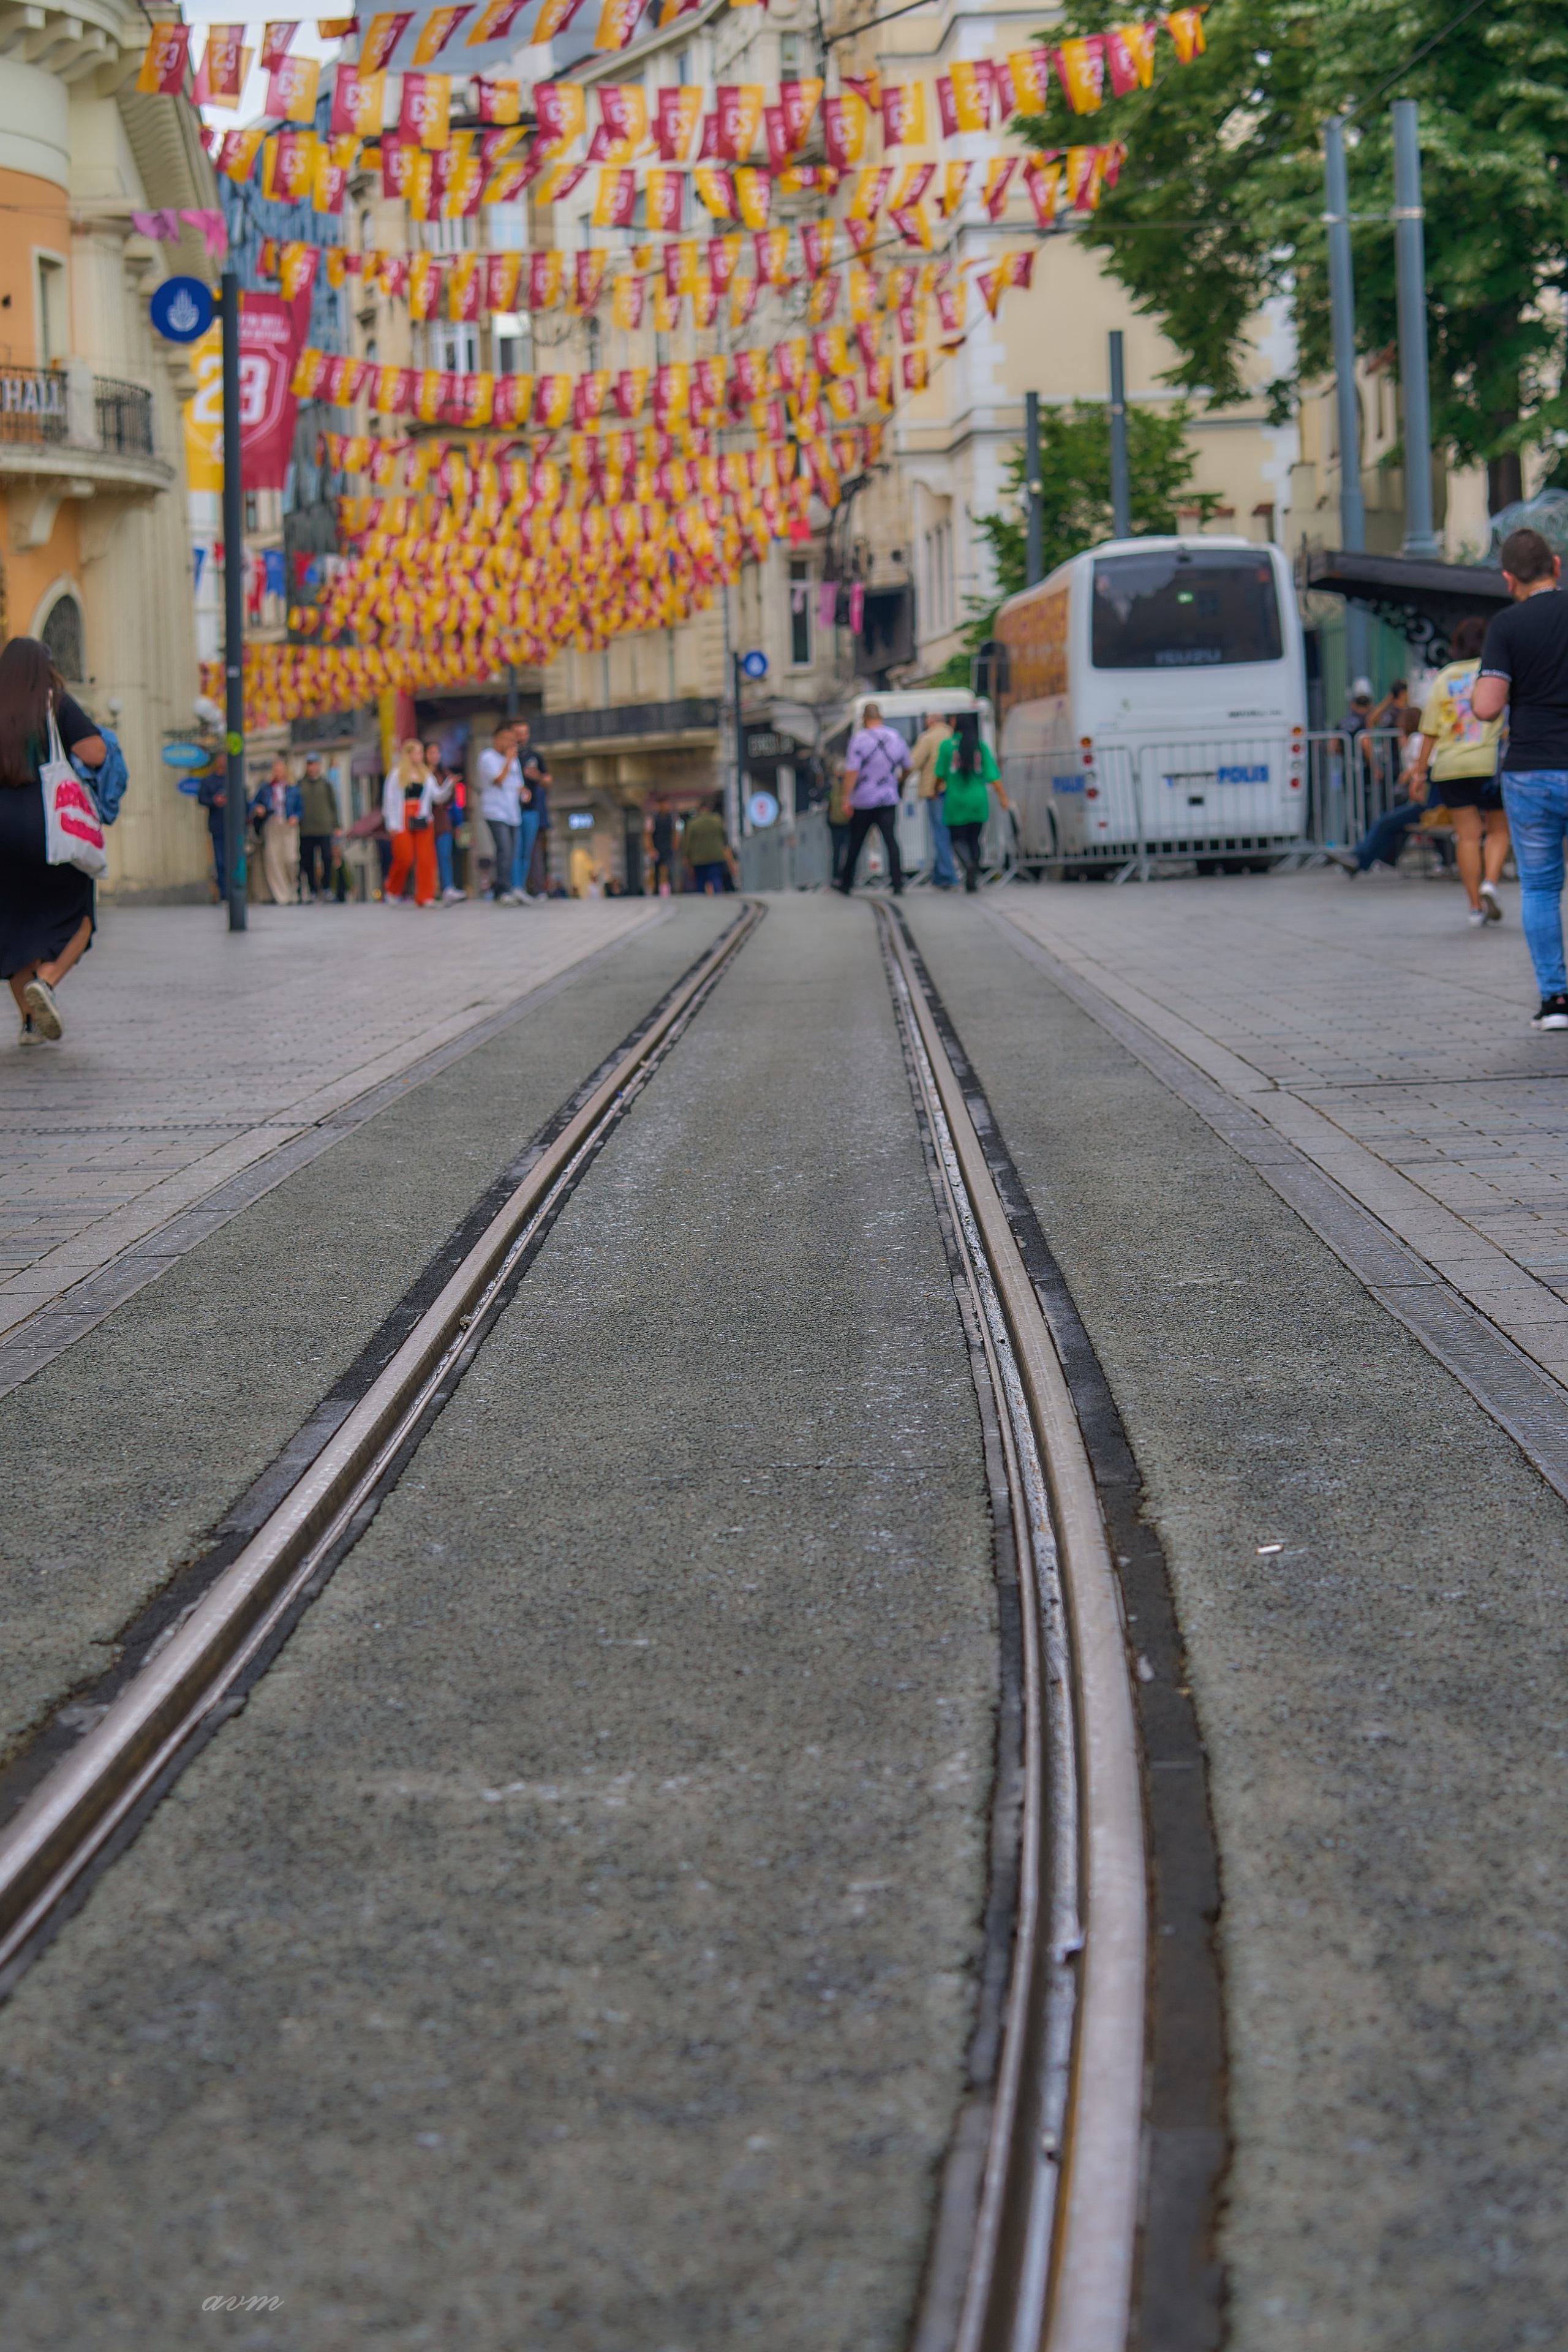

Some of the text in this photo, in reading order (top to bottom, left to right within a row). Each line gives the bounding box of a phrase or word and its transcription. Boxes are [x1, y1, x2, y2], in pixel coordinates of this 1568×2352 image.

[156, 42, 180, 69] 23
[213, 42, 237, 70] 23
[2, 377, 66, 414] HALL
[193, 353, 271, 425] 23
